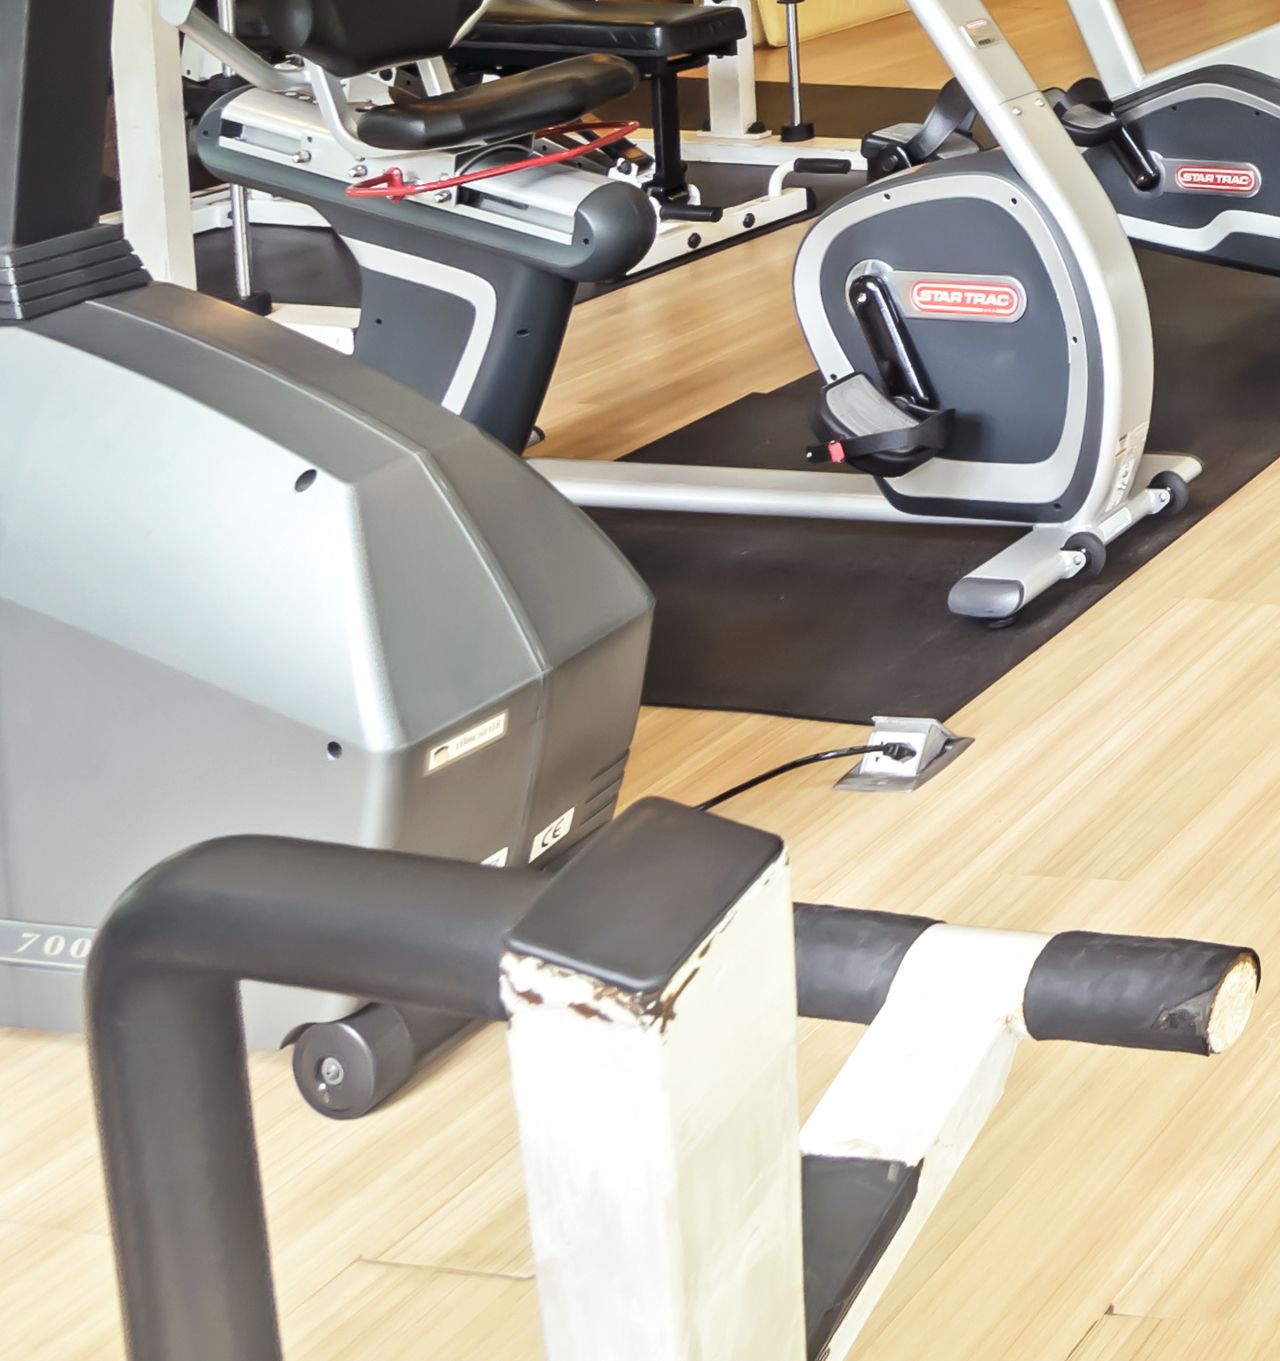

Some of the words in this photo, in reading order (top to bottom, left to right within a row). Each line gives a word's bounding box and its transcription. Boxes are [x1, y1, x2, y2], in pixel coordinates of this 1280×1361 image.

[1181, 173, 1214, 183] STAR
[1215, 175, 1249, 185] TRAC
[919, 289, 962, 303] STAR
[963, 292, 1010, 306] TRAC
